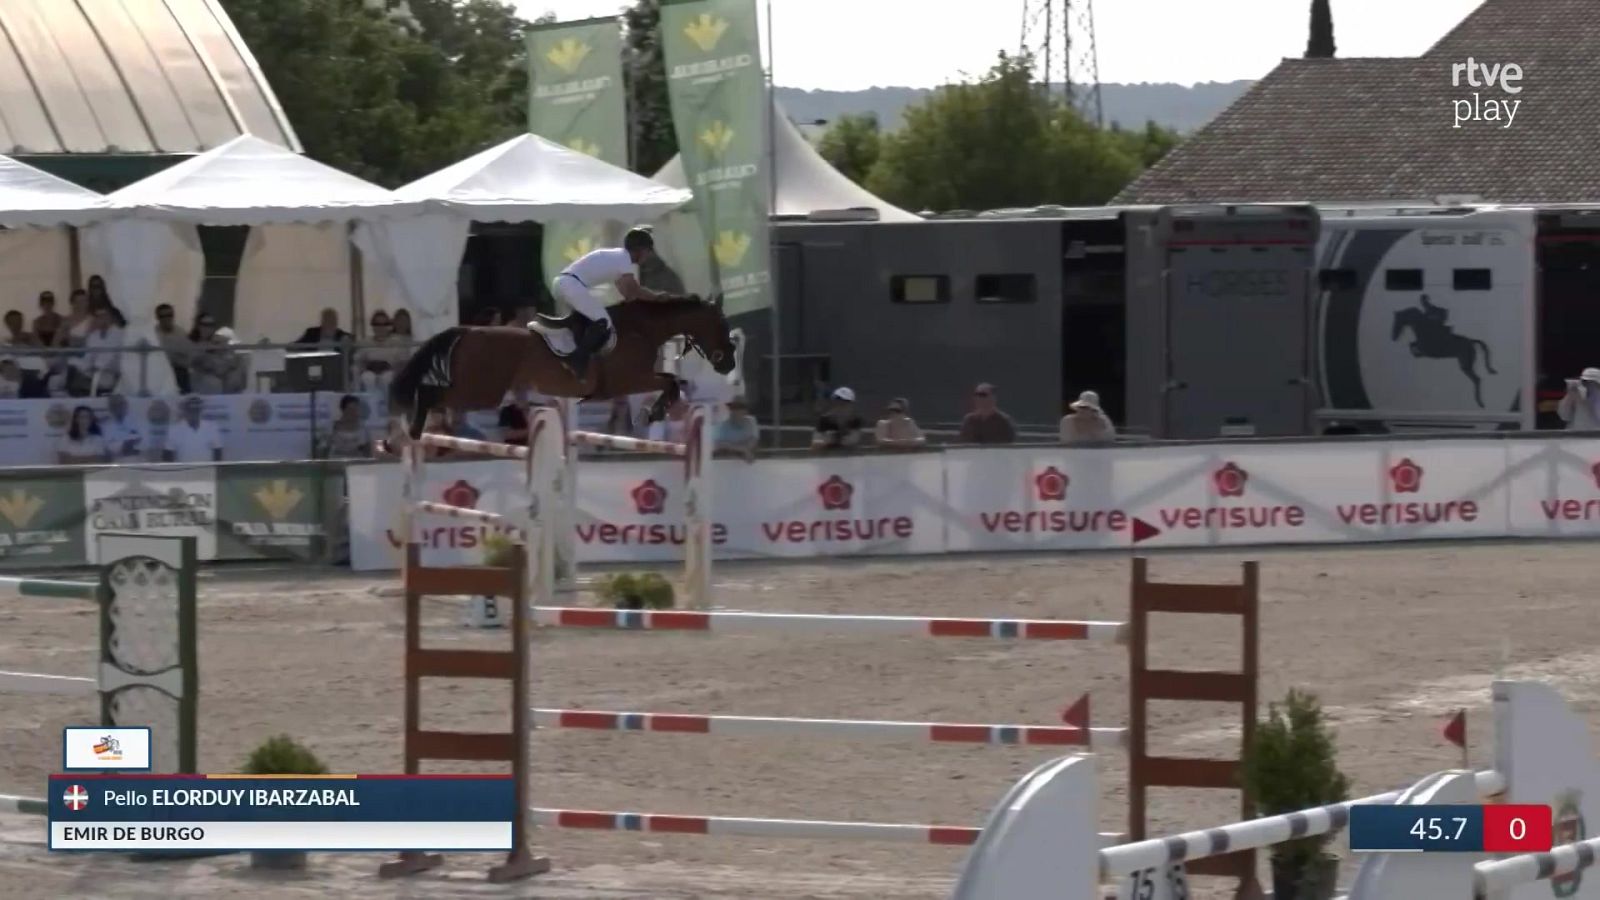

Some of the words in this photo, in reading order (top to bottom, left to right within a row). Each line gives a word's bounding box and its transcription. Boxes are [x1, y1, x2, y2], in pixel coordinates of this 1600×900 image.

[980, 506, 1127, 533] verisure
[1160, 503, 1305, 530] verisure
[1337, 498, 1478, 525] verisure
[576, 523, 728, 545] verisue
[763, 515, 913, 544] verisure
